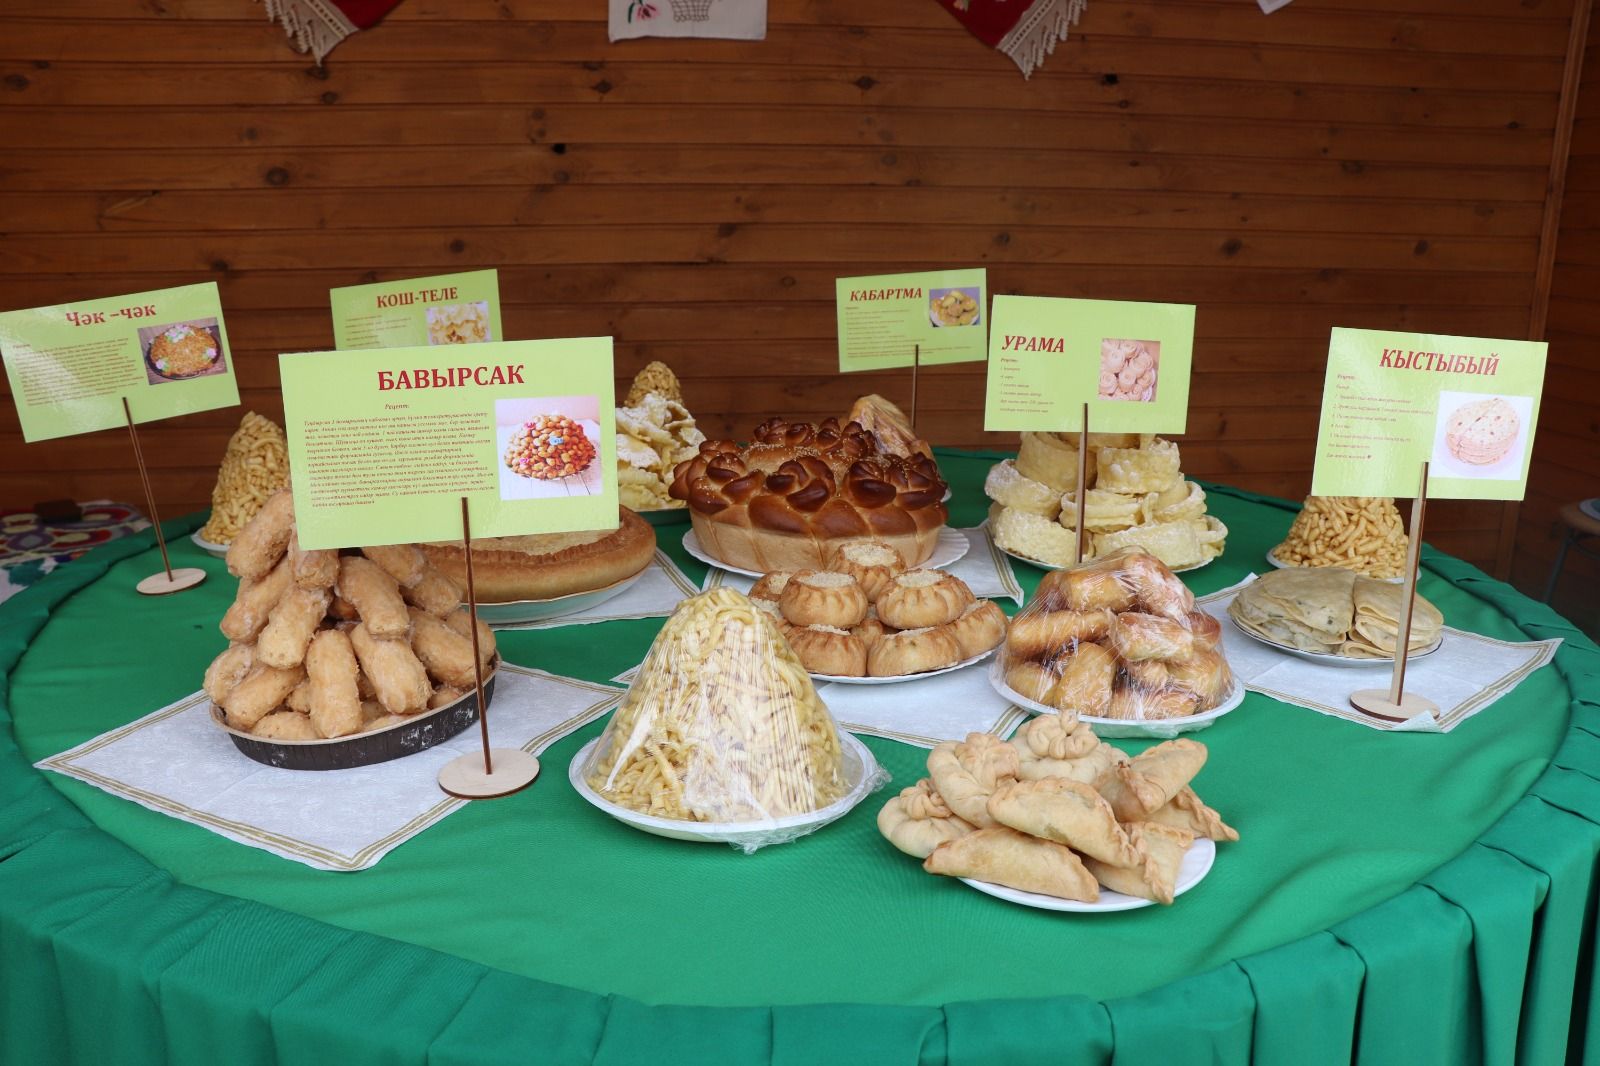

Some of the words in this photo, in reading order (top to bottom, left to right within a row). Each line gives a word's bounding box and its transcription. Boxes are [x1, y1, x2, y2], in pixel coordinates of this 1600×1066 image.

[377, 287, 458, 308] КОШ-ТЕЛЕ
[850, 288, 922, 301] КАБАРТМА
[66, 311, 106, 326] Чәк
[1002, 335, 1064, 352] УРАМА
[1379, 349, 1499, 376] КЫСТЫБЫЙ
[377, 365, 525, 391] БАВЫРСАК
